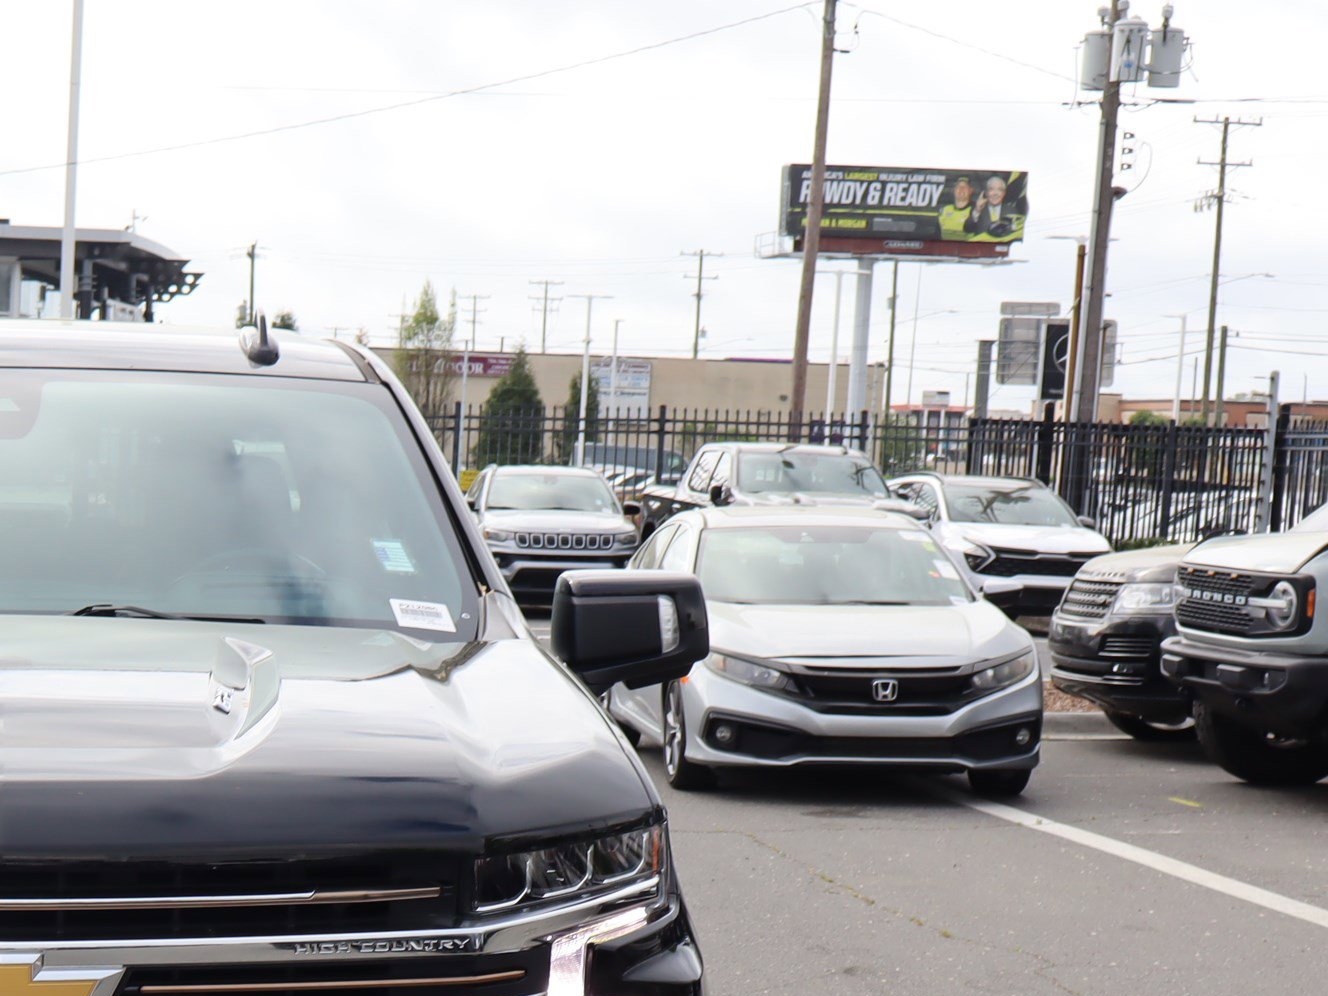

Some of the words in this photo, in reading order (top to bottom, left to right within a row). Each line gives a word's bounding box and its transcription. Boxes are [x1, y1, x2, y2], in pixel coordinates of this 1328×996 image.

[799, 180, 866, 205] RWDY
[883, 183, 945, 207] READY
[1184, 588, 1247, 606] BRONCO
[294, 943, 351, 955] HIGH
[359, 938, 471, 953] COUNTRY
